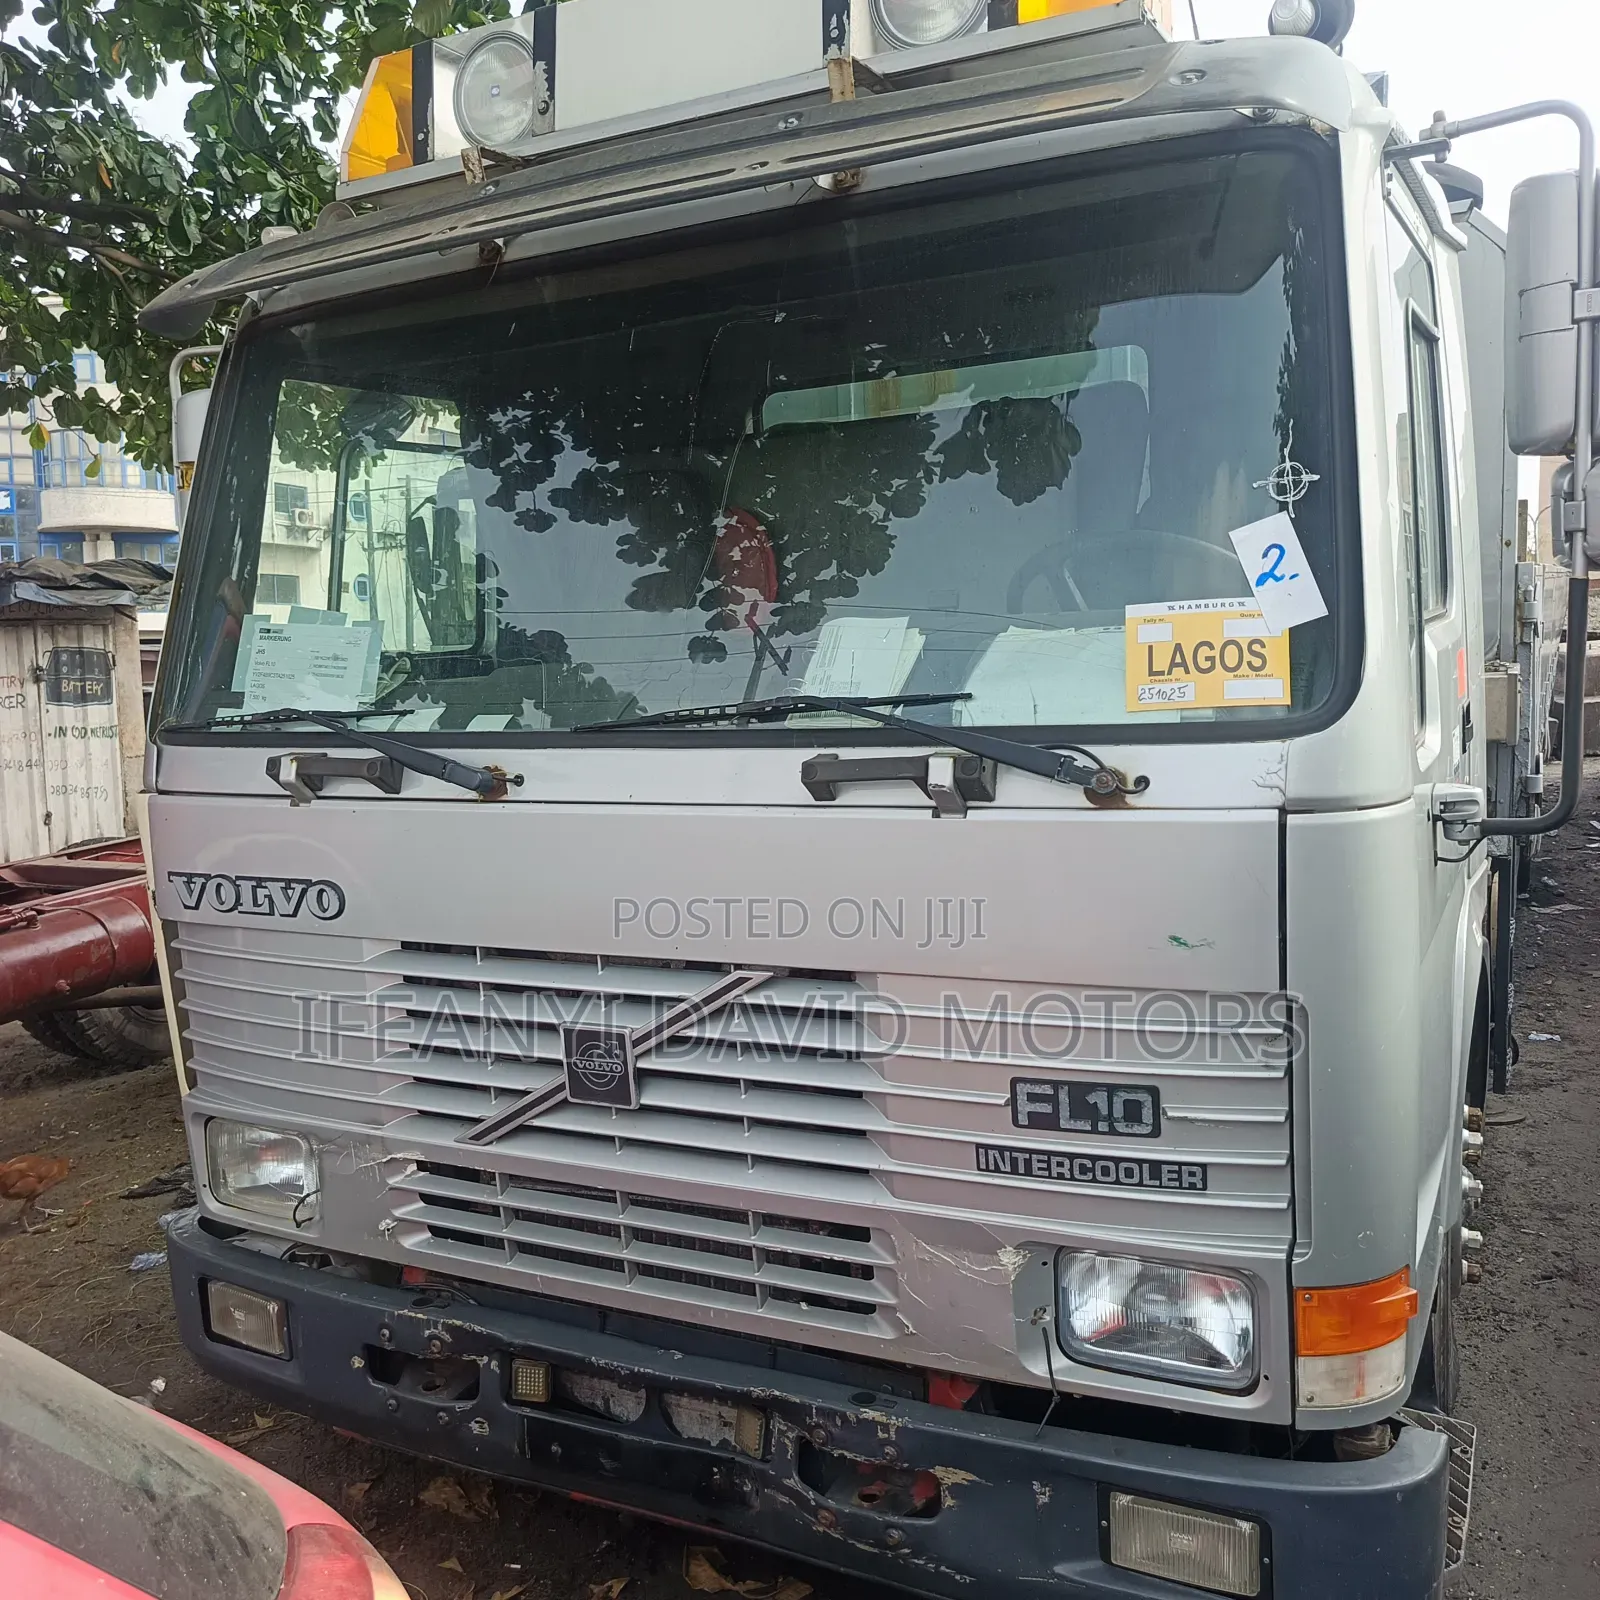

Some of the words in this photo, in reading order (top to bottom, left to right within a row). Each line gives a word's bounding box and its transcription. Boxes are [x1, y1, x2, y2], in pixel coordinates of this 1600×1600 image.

[1178, 601, 1235, 611] HAMBURG
[259, 634, 292, 643] MARKIERUNG
[1147, 638, 1268, 677] LAGOS
[1138, 684, 1189, 702] 251025
[54, 725, 68, 739] IN
[168, 871, 346, 921] VOLVO
[576, 1059, 622, 1073] VOLVO
[1015, 1082, 1153, 1135] FL10
[978, 1148, 1204, 1189] INTERCOOLER
